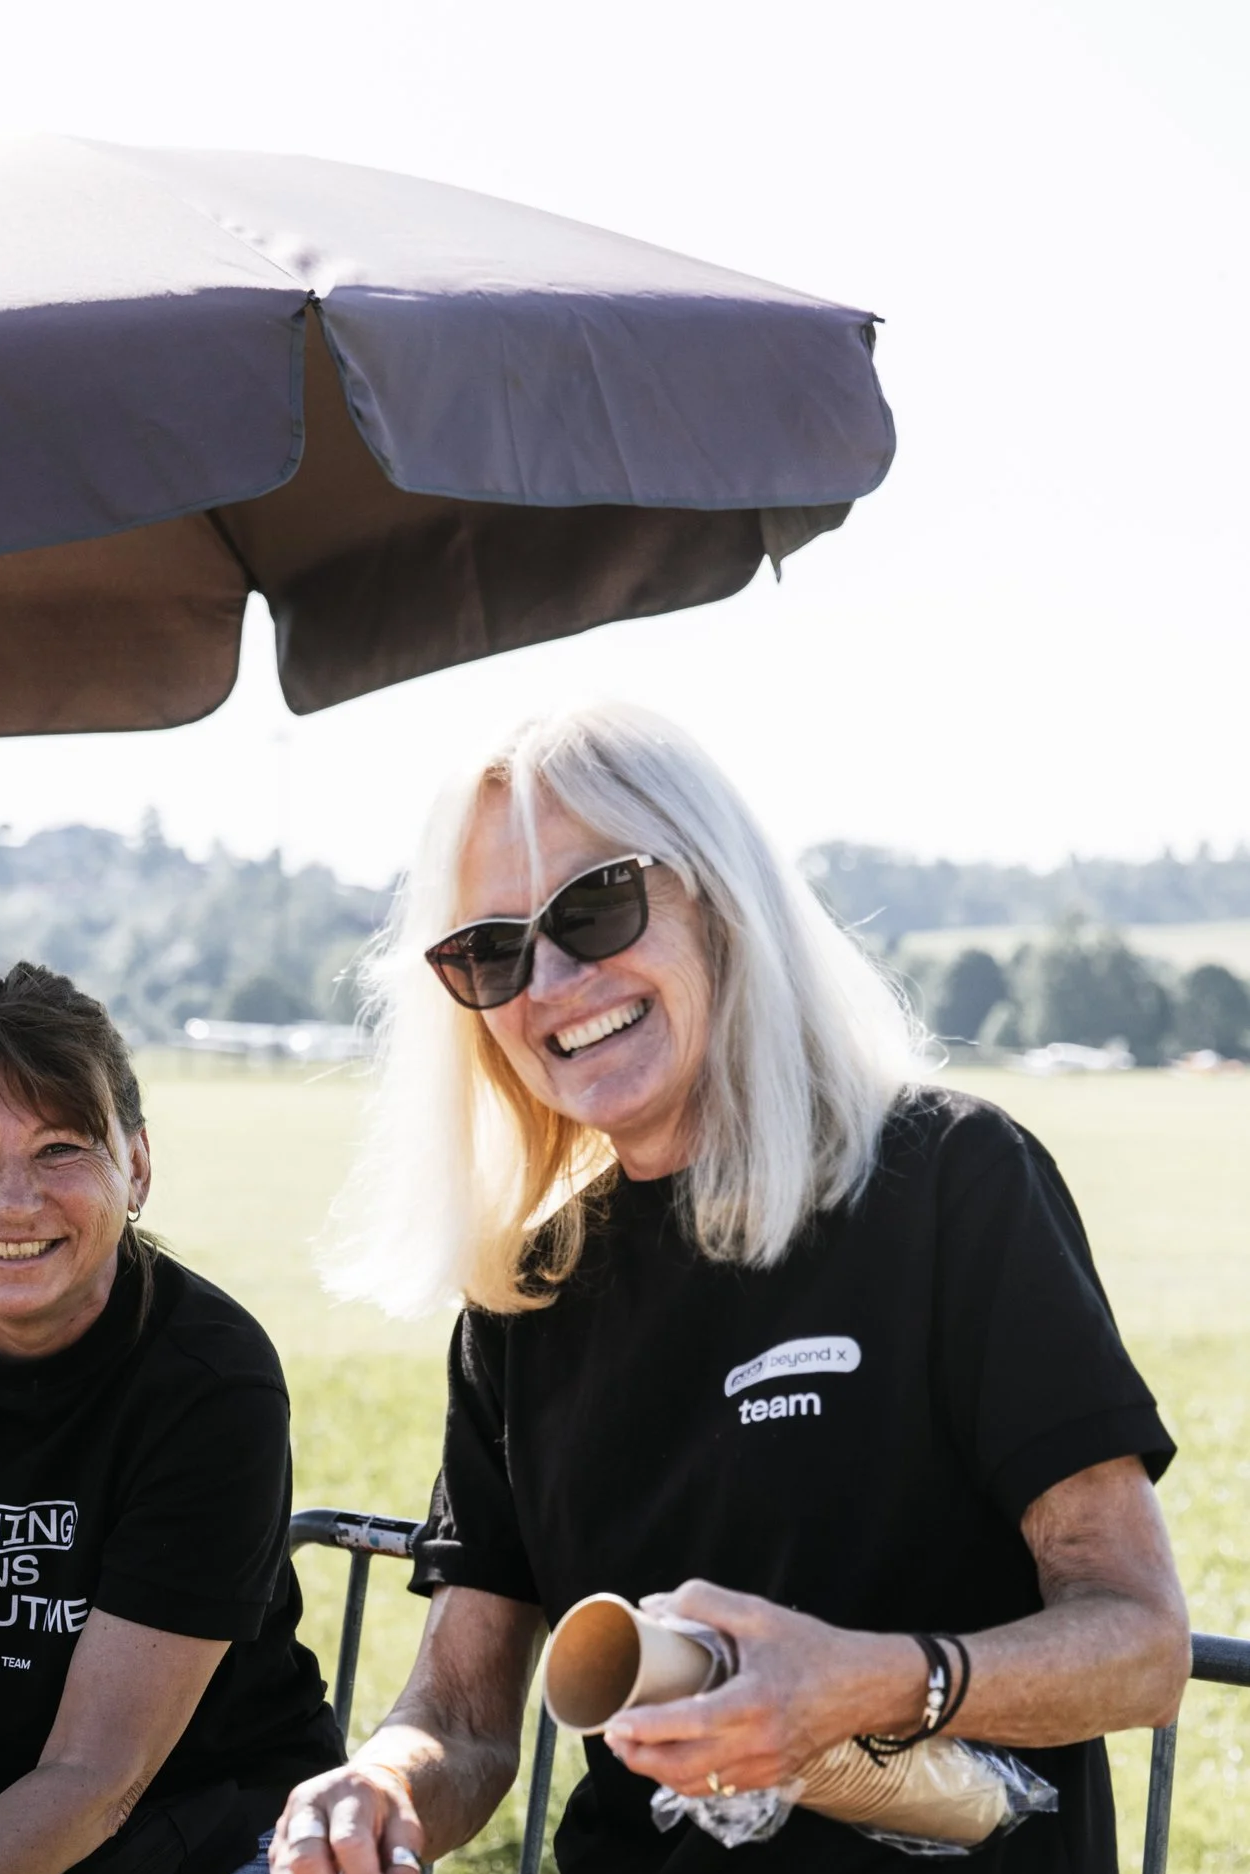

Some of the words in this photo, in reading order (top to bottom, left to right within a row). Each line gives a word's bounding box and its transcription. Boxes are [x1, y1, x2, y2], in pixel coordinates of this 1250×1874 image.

[770, 1347, 831, 1367] beyond
[836, 1350, 847, 1361] x
[738, 1391, 821, 1425] team
[1, 1656, 31, 1670] TEAM
